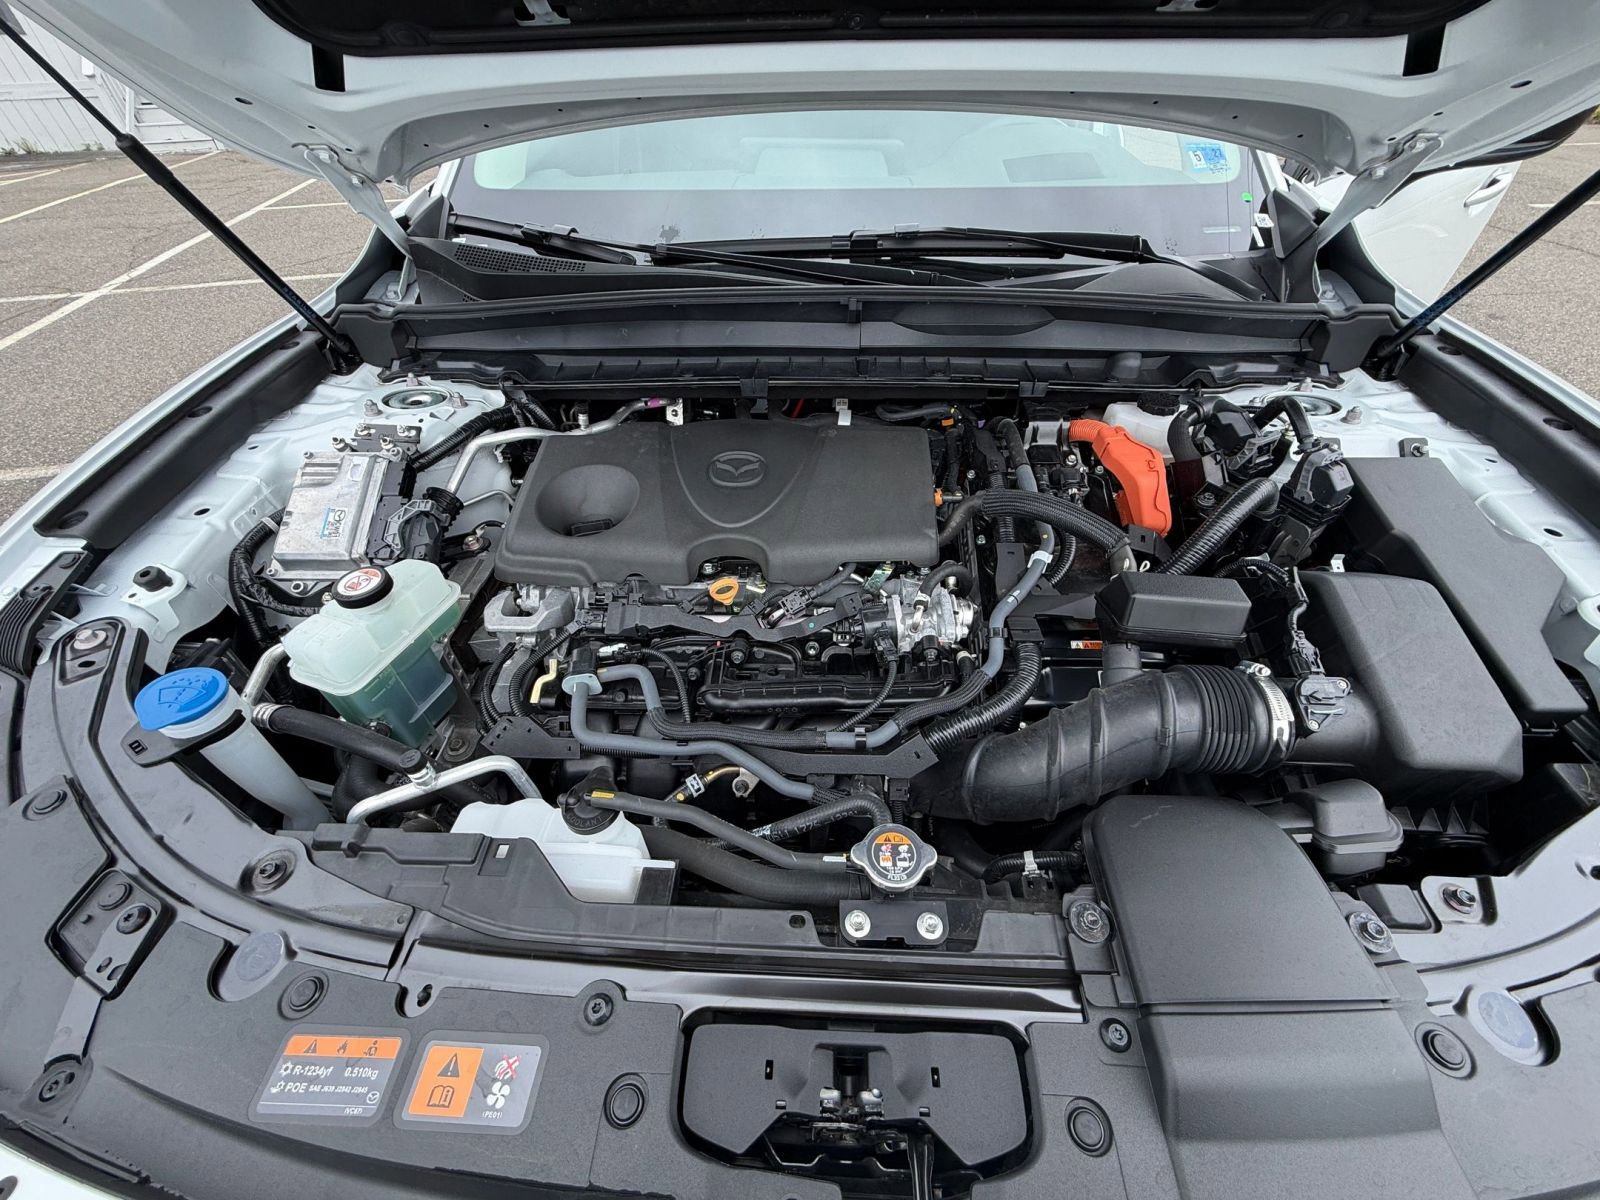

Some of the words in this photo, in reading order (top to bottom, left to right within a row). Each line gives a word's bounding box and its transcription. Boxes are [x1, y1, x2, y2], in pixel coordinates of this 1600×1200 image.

[566, 813, 604, 827] COOLANT
[293, 1065, 333, 1078] R-1234yf
[345, 1067, 379, 1080] 0.510kg
[286, 1083, 307, 1093] POE
